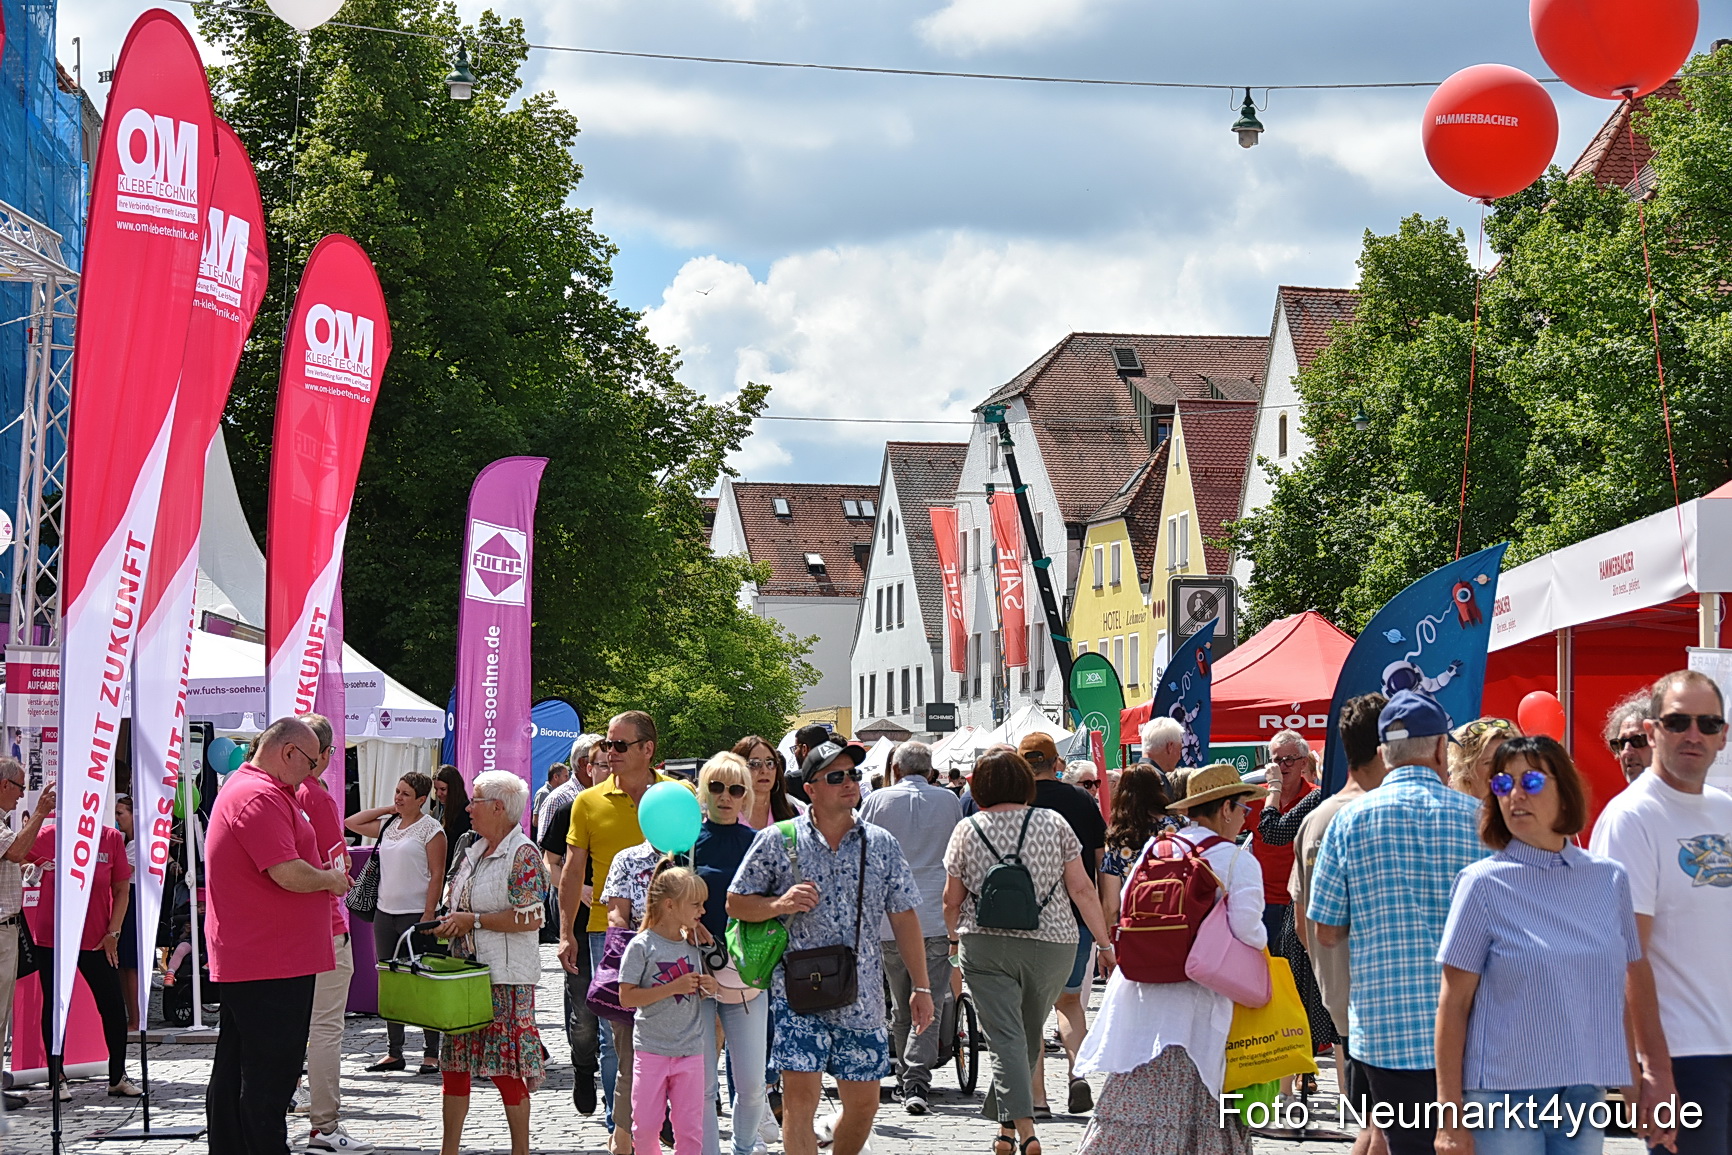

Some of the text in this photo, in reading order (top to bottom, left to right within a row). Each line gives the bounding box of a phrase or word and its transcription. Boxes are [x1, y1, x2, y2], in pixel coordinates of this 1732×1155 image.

[1435, 113, 1518, 127] HAMMERBACHER
[117, 108, 198, 186] OM
[118, 176, 196, 203] KLEBETECHNIK
[118, 199, 129, 208] Ihre
[175, 208, 196, 221] Leistung
[201, 206, 250, 274] M
[305, 303, 374, 367] OM
[306, 351, 370, 376] KLEBETECHNK
[1103, 610, 1122, 632] HOTEL
[32, 668, 60, 678] GEMEINS
[294, 607, 327, 718] UKUNFT
[27, 698, 53, 708] Verstärkung
[70, 529, 146, 892] JOBS MIT ZUKUNFT
[479, 625, 501, 774] uchs-soehne.de
[27, 708, 58, 717] folgenden Ber
[394, 716, 437, 724] www.fuchs-soehne.de
[45, 731, 58, 739] PROD
[540, 727, 578, 739] Bionorica
[148, 726, 183, 887] JOBS MIT
[1281, 1028, 1304, 1038] Uno
[1238, 1054, 1289, 1068] Dreierkombination
[1239, 1051, 1273, 1061] einzigartigen
[1273, 1043, 1305, 1055] pflanzlichen
